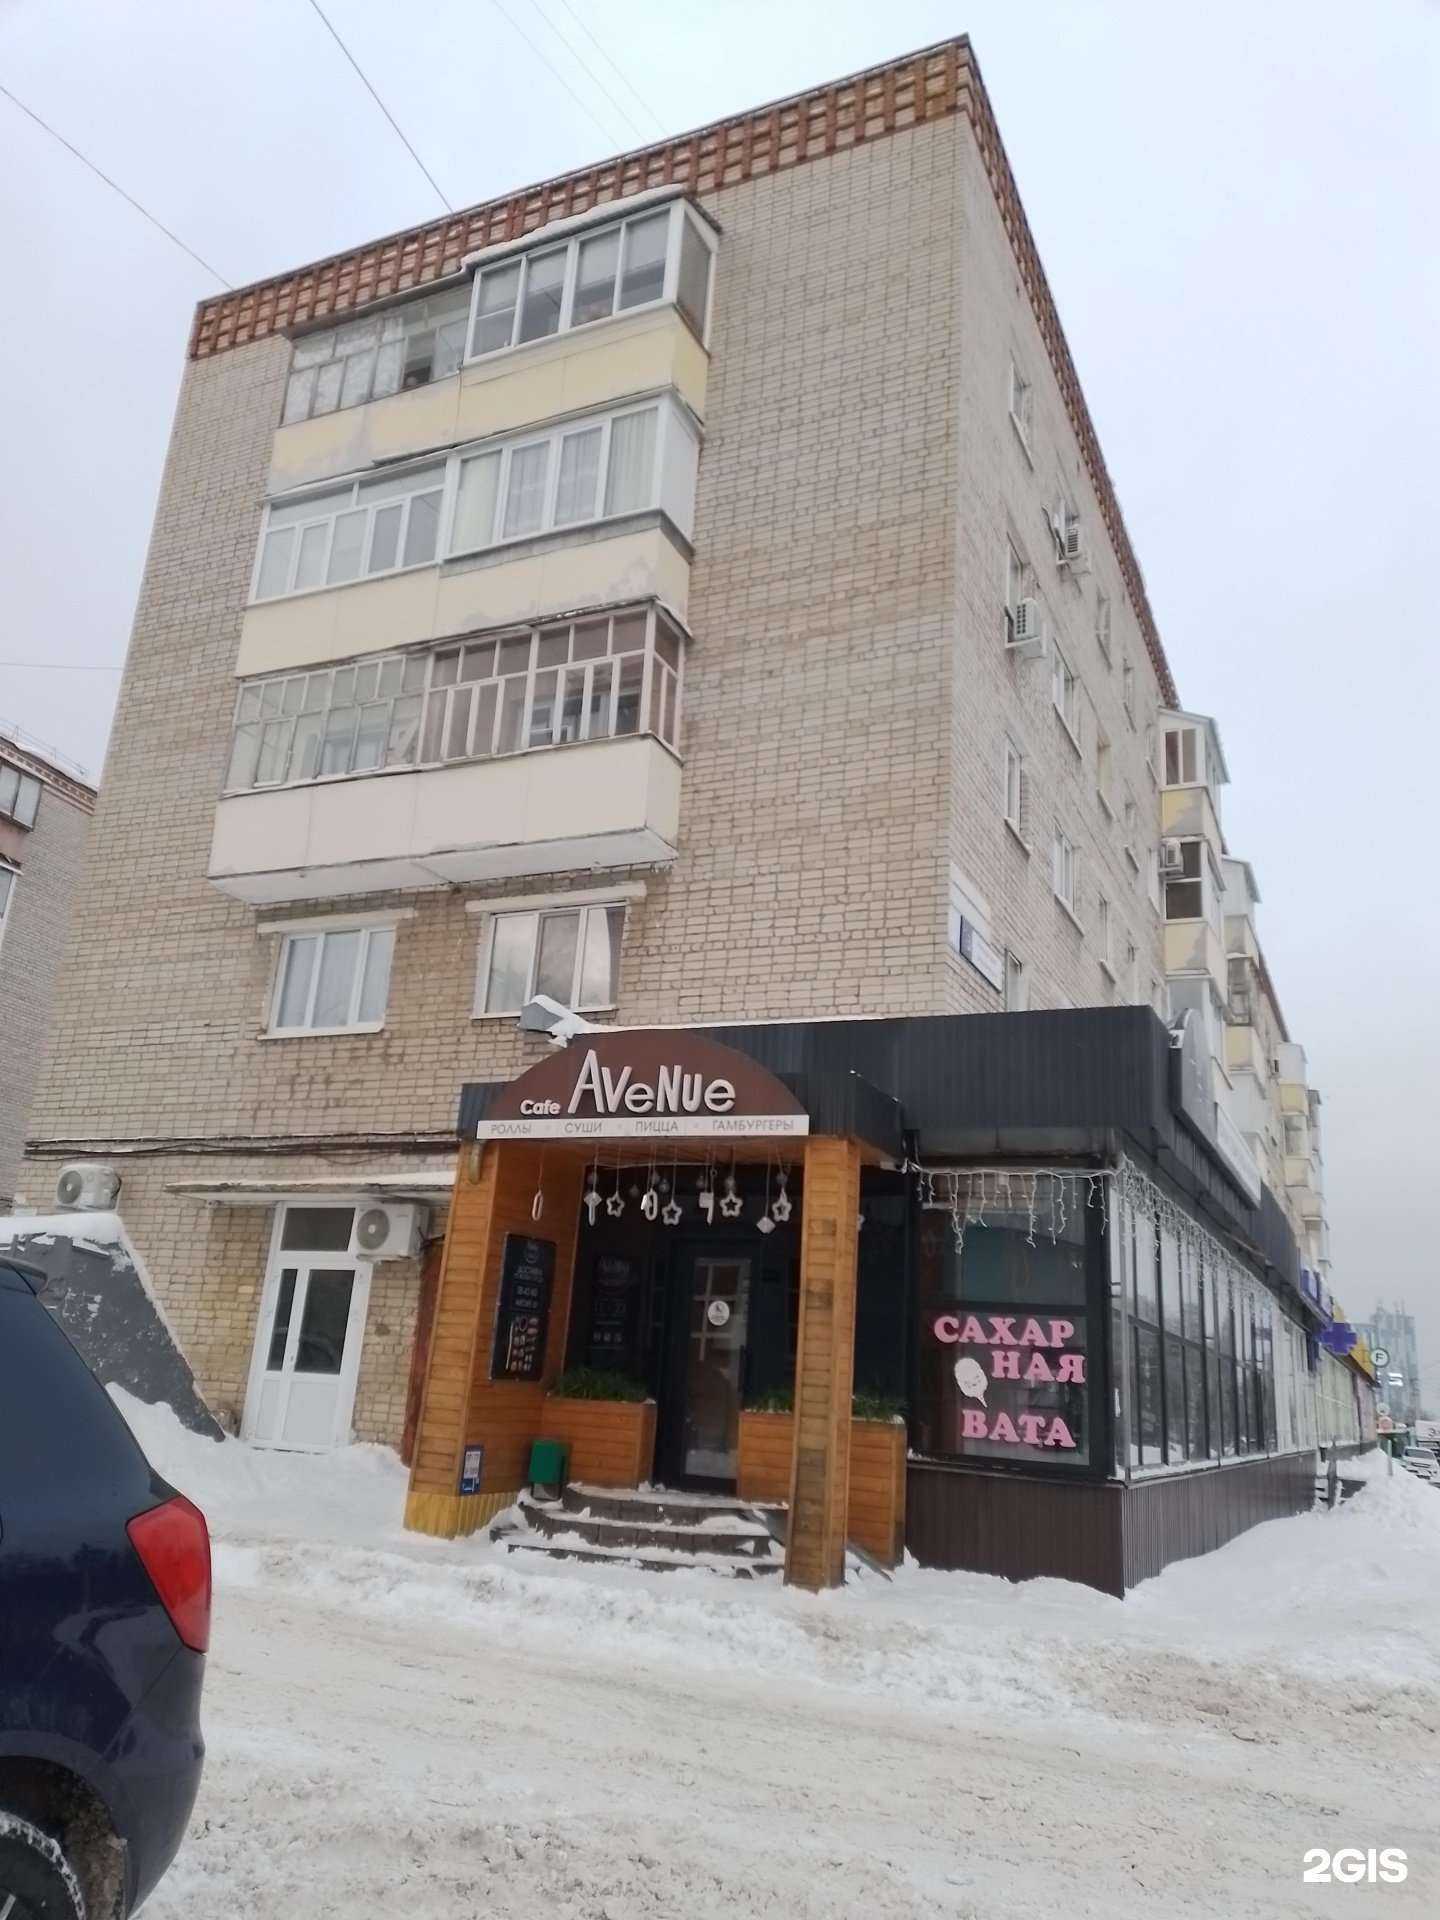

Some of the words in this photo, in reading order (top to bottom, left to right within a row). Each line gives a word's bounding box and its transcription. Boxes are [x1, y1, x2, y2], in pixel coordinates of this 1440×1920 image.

[520, 1099, 562, 1116] Cafe
[567, 1048, 737, 1115] AVeNUe
[490, 1123, 532, 1135] РОЛЛЫ
[564, 1121, 602, 1134] СУШИ
[634, 1120, 679, 1133] ПИЦЦА
[712, 1118, 794, 1131] ГАМБУРГЕРЫ
[933, 1315, 1075, 1348] САХАР
[991, 1351, 1086, 1384] НАЯ
[961, 1409, 1077, 1448] ВАТА
